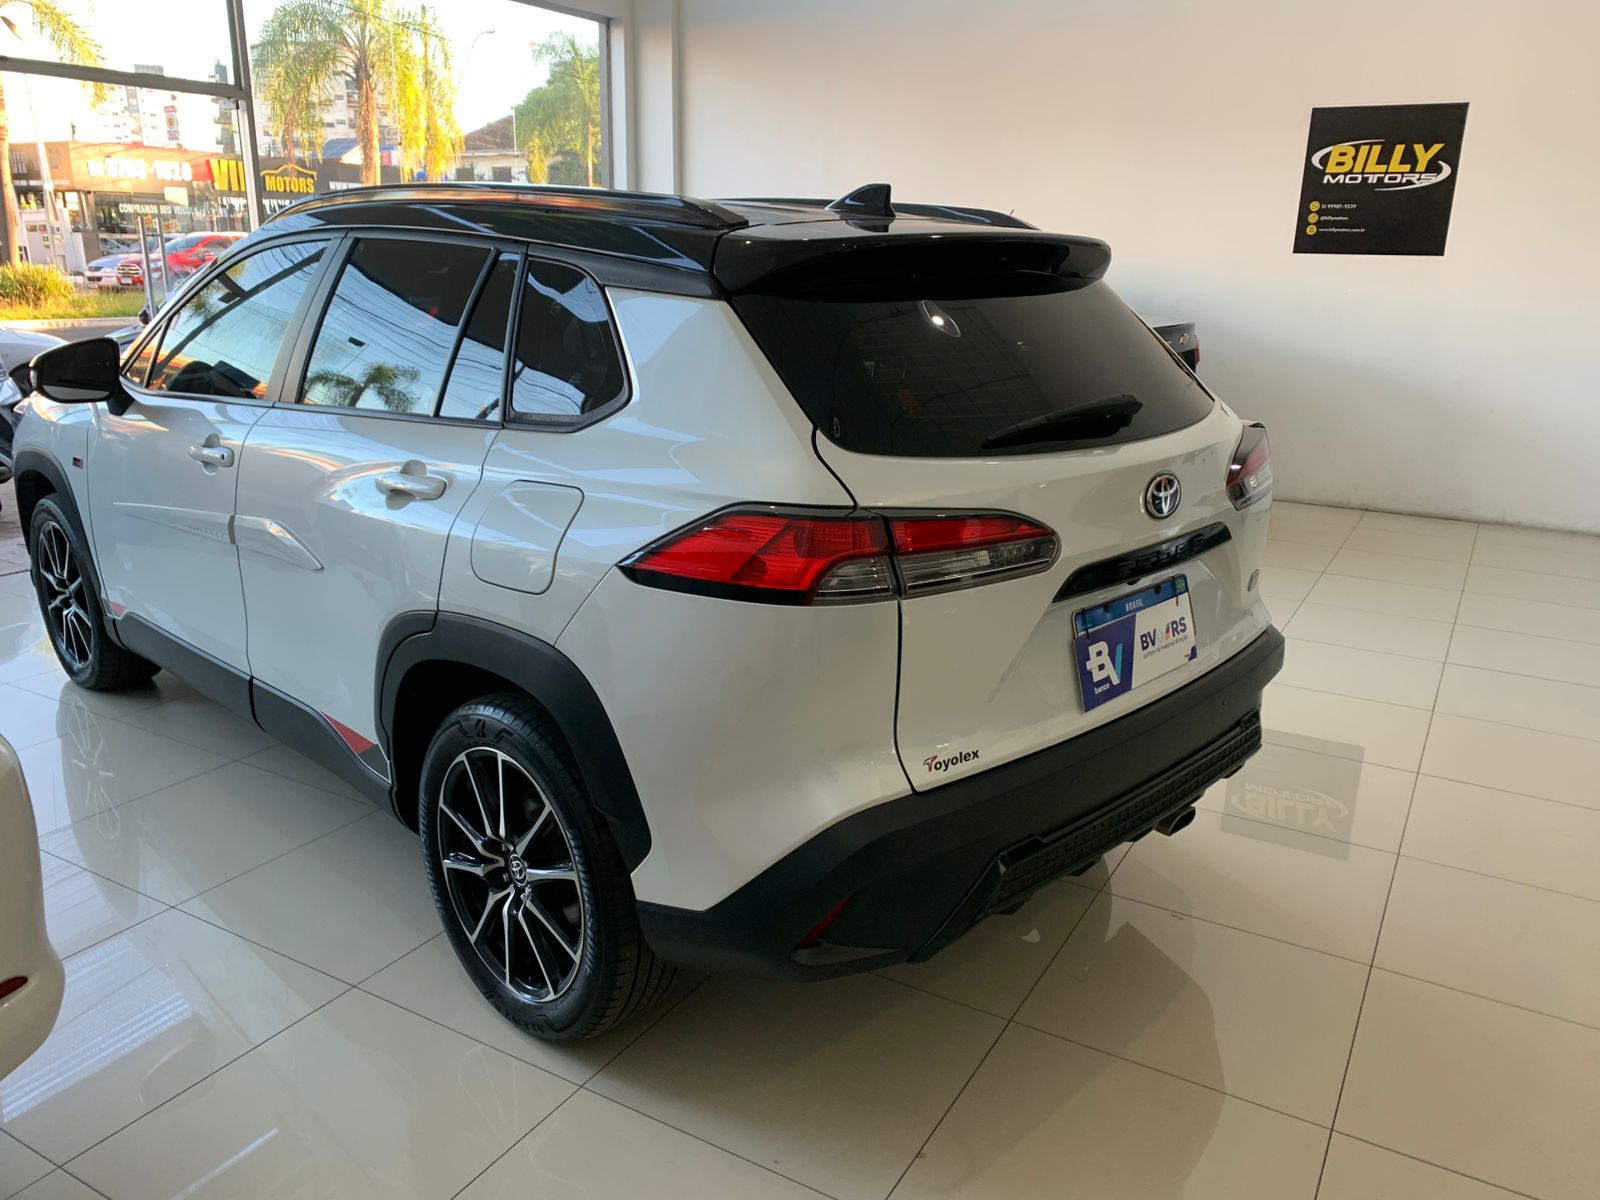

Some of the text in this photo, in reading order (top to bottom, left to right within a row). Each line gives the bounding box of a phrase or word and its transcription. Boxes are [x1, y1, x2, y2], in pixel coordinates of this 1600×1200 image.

[1325, 143, 1446, 174] BILLY
[265, 175, 315, 194] MOTORS
[1322, 173, 1438, 185] MOTORS
[118, 203, 159, 215] COMPRAMOS
[160, 205, 172, 215] SEU
[1125, 598, 1144, 612] BRASIL
[1140, 616, 1187, 651] BV RS
[1094, 682, 1111, 695] banco
[923, 749, 980, 773] Toyolex
